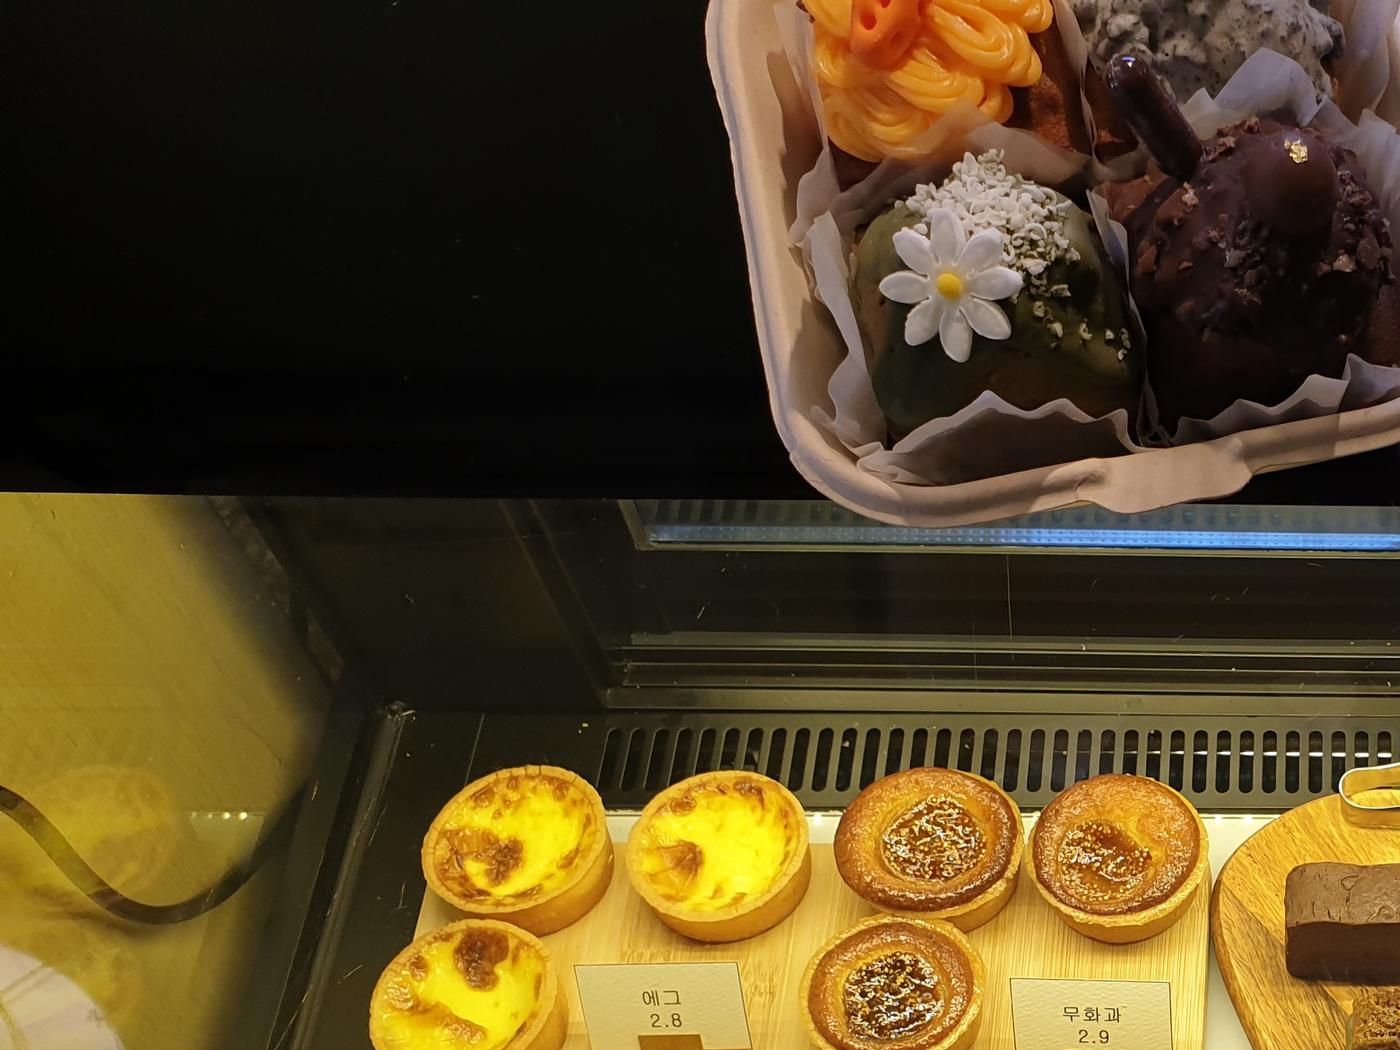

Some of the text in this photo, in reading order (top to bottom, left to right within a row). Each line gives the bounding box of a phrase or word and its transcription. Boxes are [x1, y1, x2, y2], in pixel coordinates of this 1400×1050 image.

[641, 989, 682, 1007] 에그
[649, 1012, 683, 1028] 2.8
[1062, 1006, 1123, 1024] 무화과
[1078, 1029, 1110, 1045] 2.9
